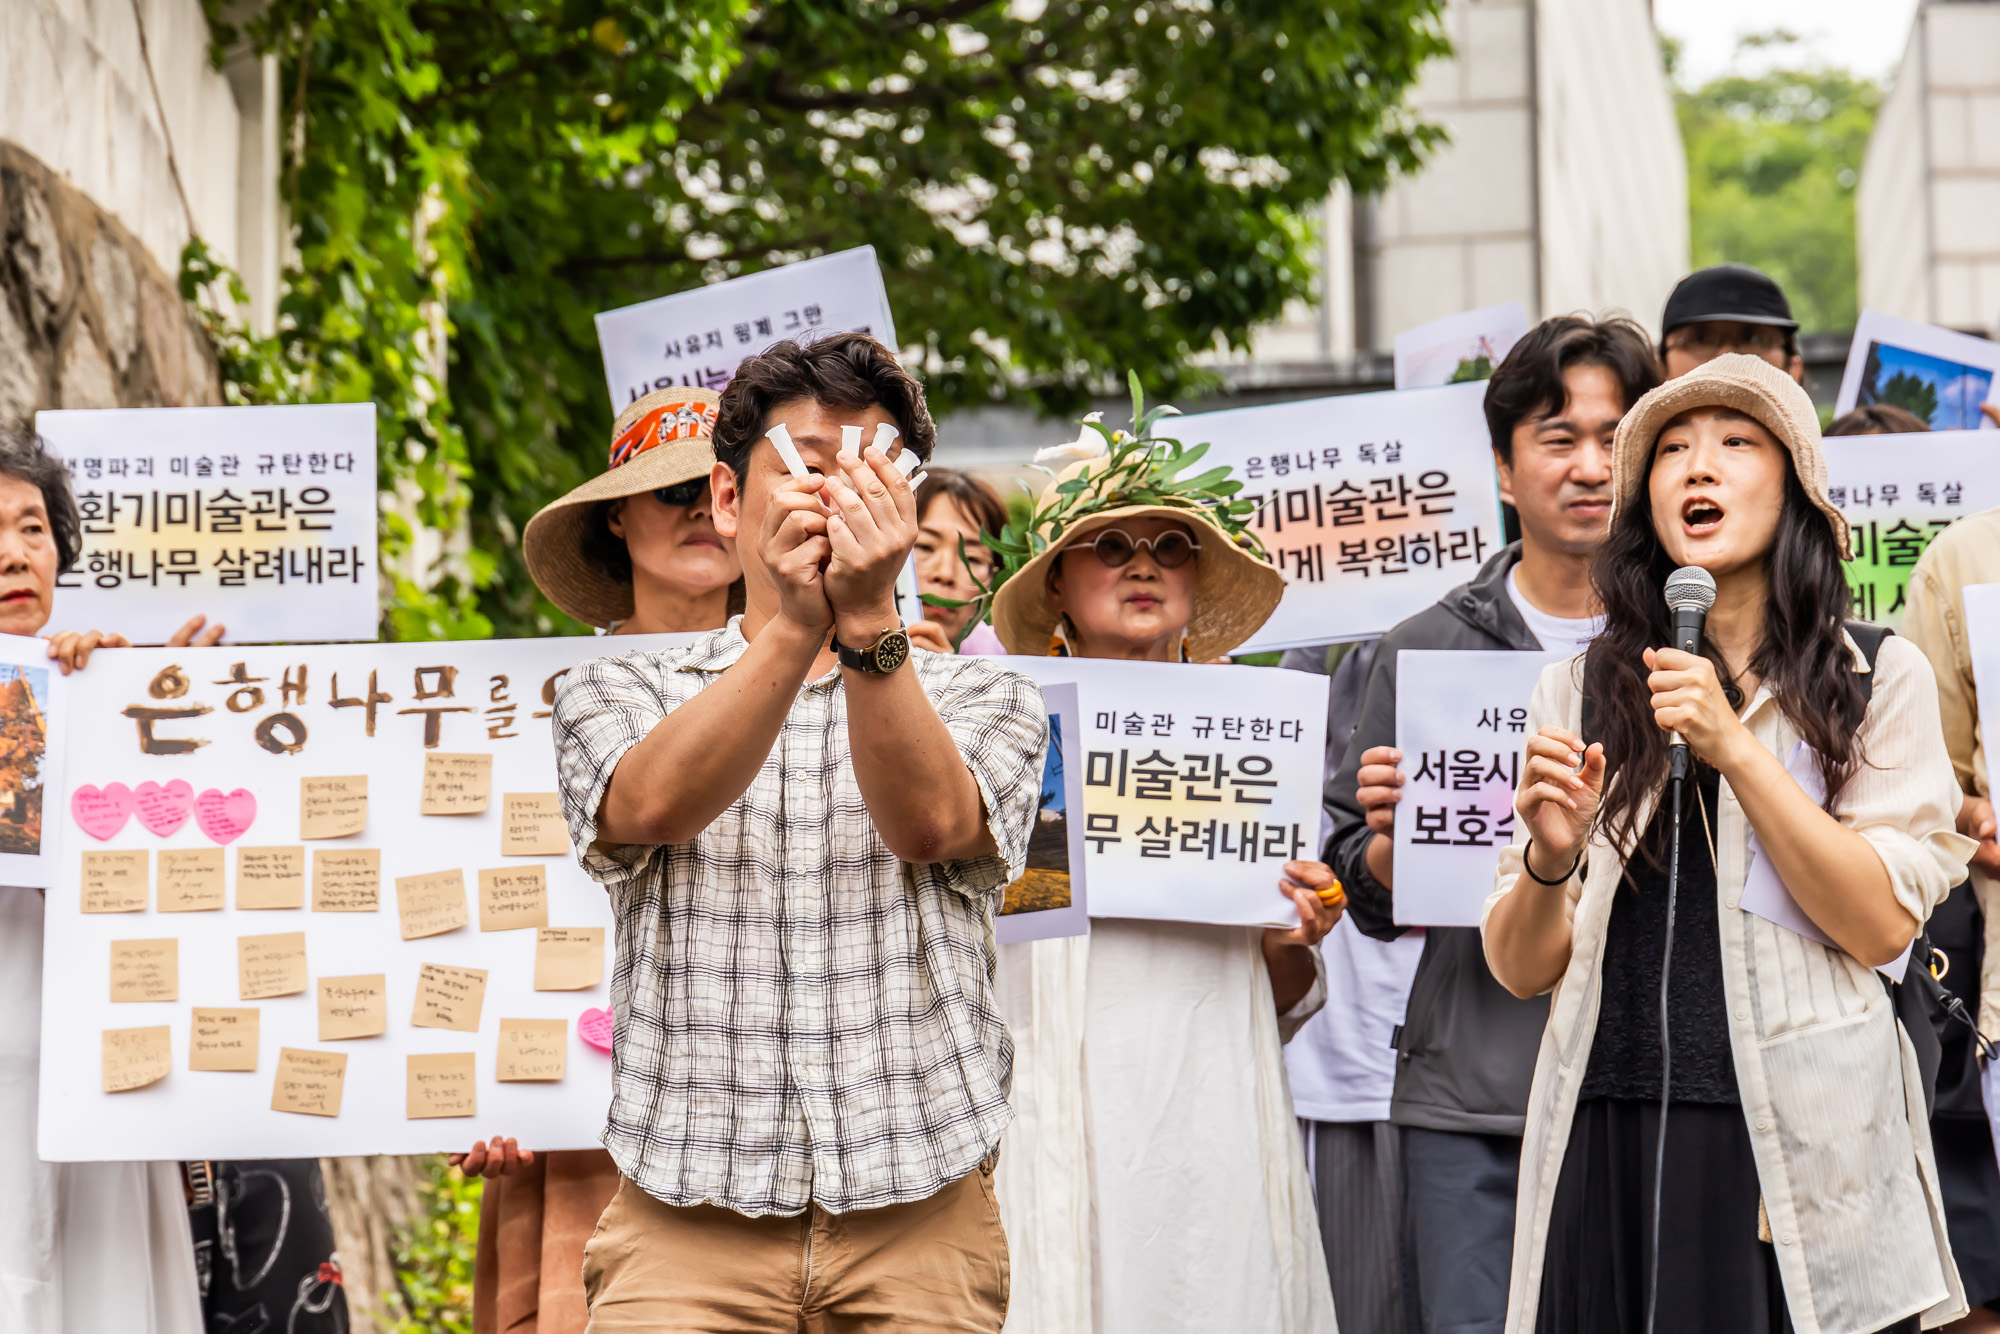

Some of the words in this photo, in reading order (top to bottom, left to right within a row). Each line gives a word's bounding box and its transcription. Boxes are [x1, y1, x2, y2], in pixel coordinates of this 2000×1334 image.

[664, 329, 723, 359] 사유지
[783, 304, 823, 331] 그만
[171, 456, 240, 477] 미술관
[257, 452, 355, 475] 규탄한다
[1246, 447, 1342, 480] 은행나무
[1358, 440, 1403, 465] 독살
[77, 486, 336, 534] 환기미술관은
[1202, 470, 1456, 533] 기미술관은
[1917, 482, 1963, 505] 독살
[214, 545, 365, 587] 살려내라
[1337, 526, 1487, 578] 복원하라
[121, 661, 519, 755] 은행나무를
[1096, 711, 1175, 737] 미술관
[1191, 715, 1304, 743] 규탄한다
[1086, 748, 1278, 804] 미술관은
[1413, 749, 1519, 792] 서울시
[1135, 816, 1307, 864] 살려내라
